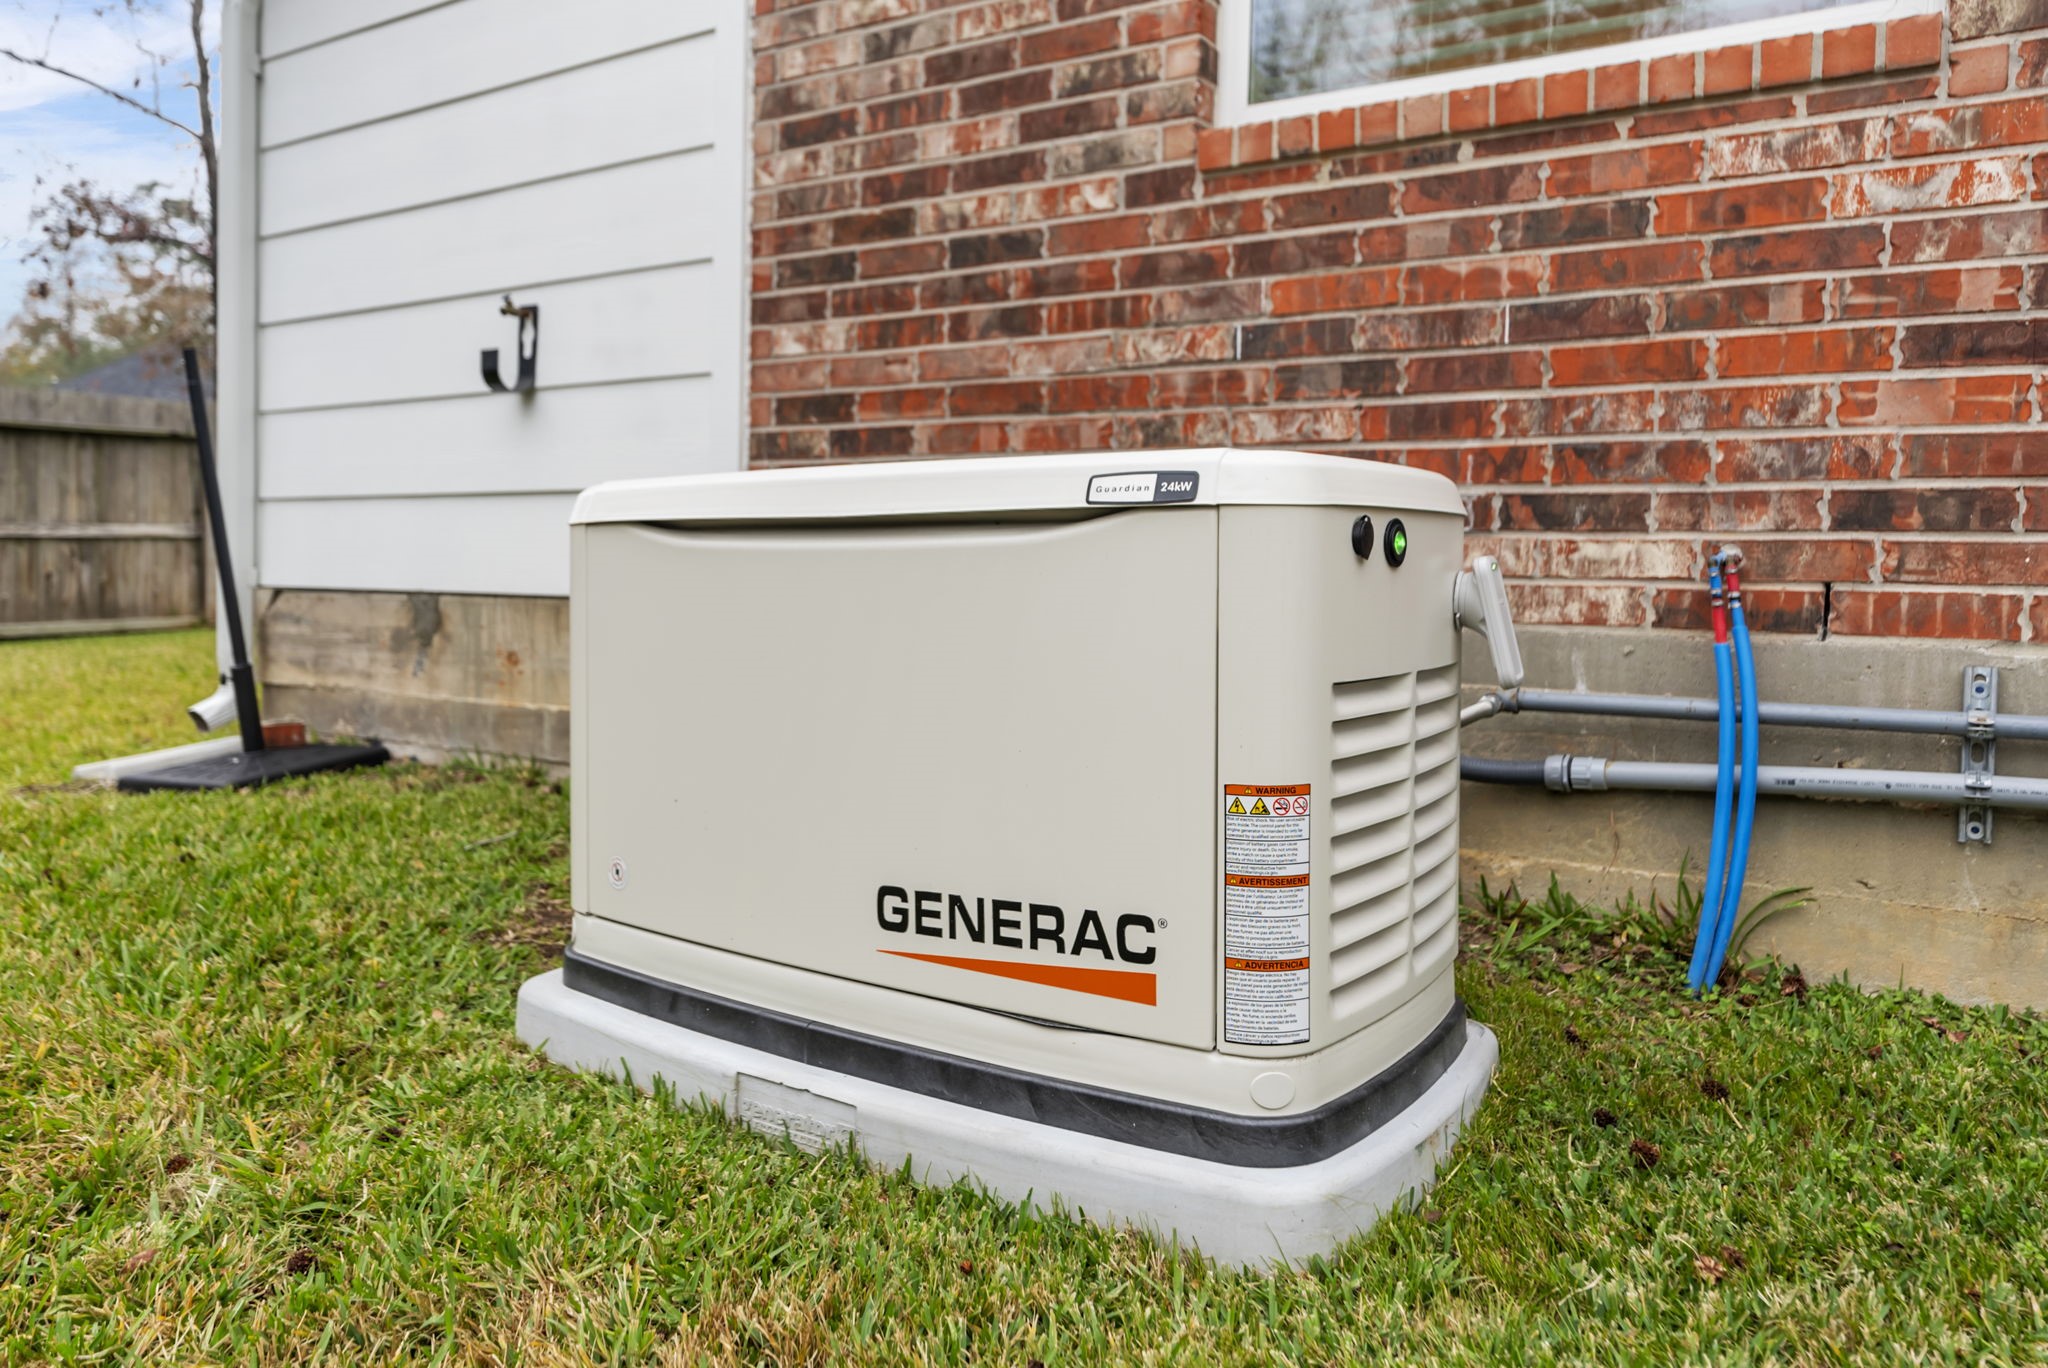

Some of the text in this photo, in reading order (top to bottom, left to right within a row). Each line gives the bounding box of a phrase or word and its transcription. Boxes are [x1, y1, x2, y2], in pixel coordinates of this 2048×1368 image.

[1095, 481, 1193, 494] Guardian 24kW
[1255, 786, 1297, 795] WARNING
[1239, 877, 1307, 886] AVERTISSEMENT
[1245, 960, 1304, 969] ADVERTENCIA
